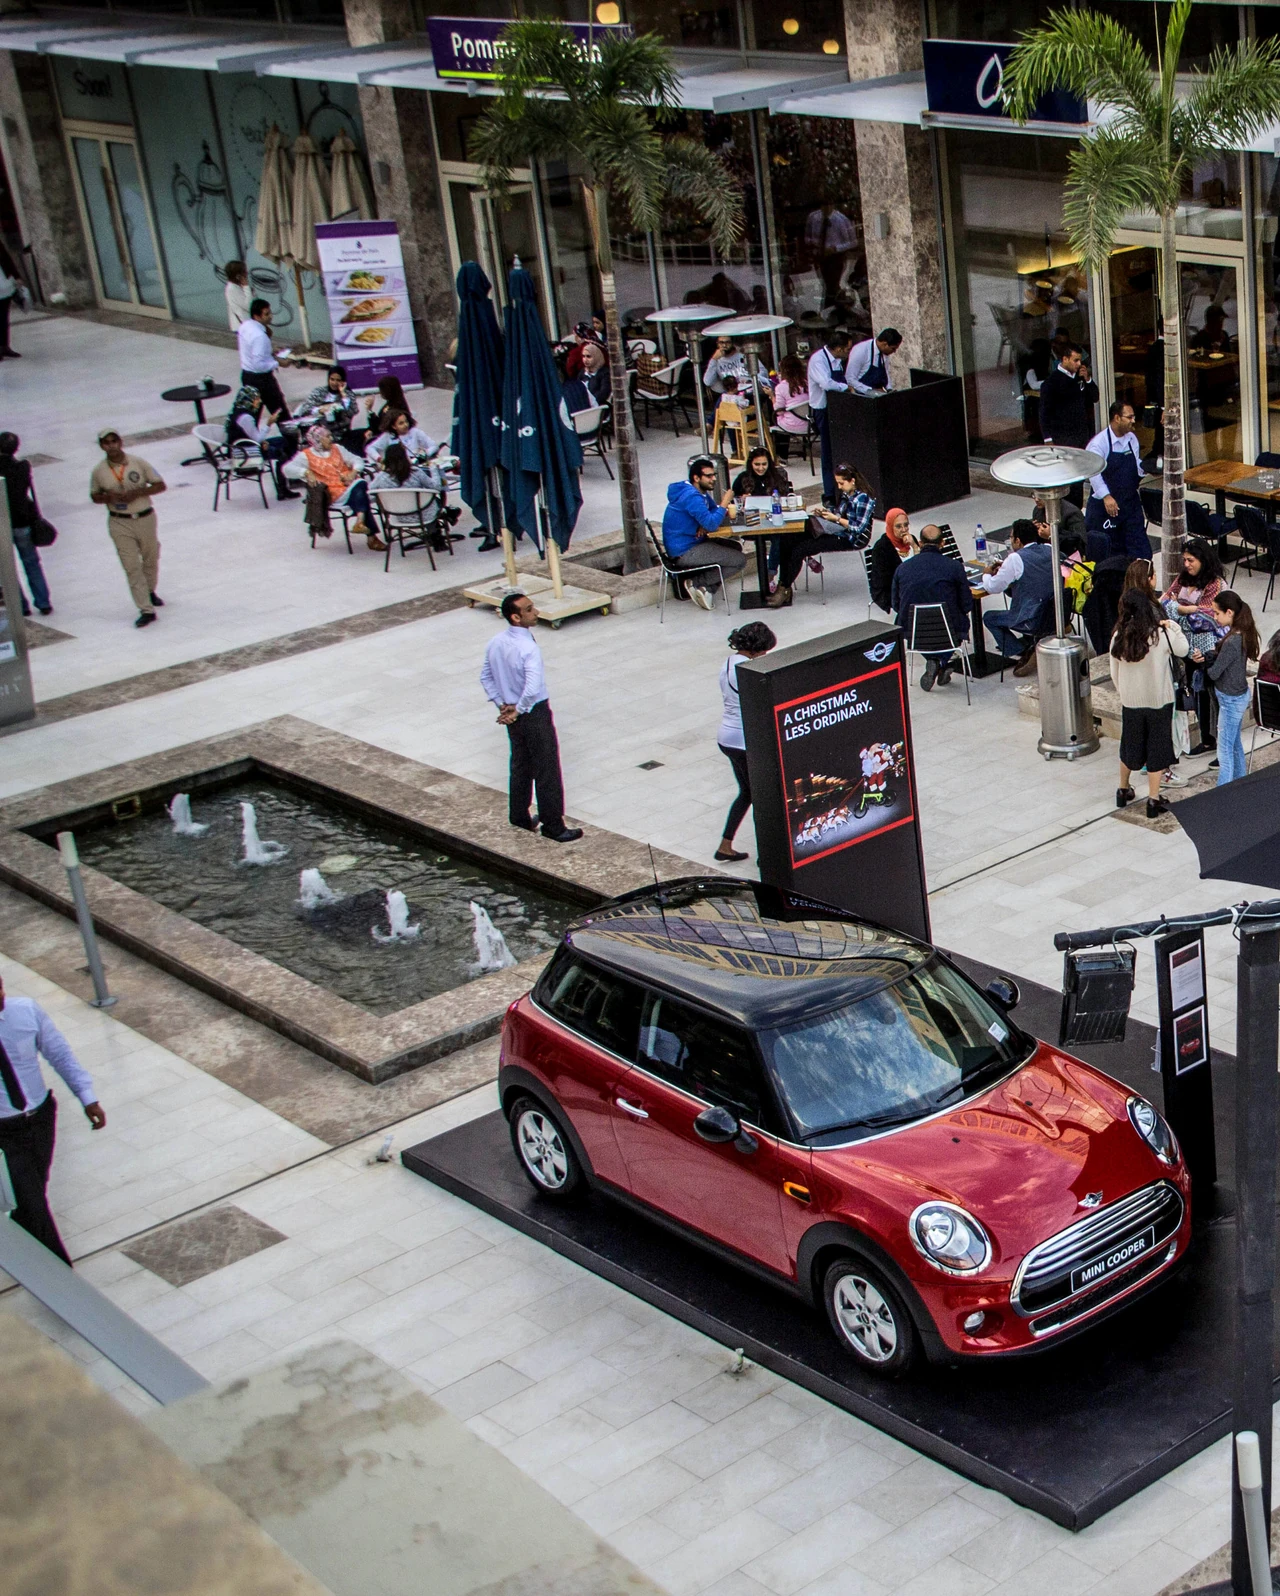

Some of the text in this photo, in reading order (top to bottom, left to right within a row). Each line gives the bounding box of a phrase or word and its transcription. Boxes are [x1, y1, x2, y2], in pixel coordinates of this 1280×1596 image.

[451, 32, 517, 60] Pomm
[783, 689, 858, 726] A CHRISTMAS
[785, 700, 873, 741] LESS ORDINARY.
[1081, 1238, 1145, 1282] MINI COOPER
